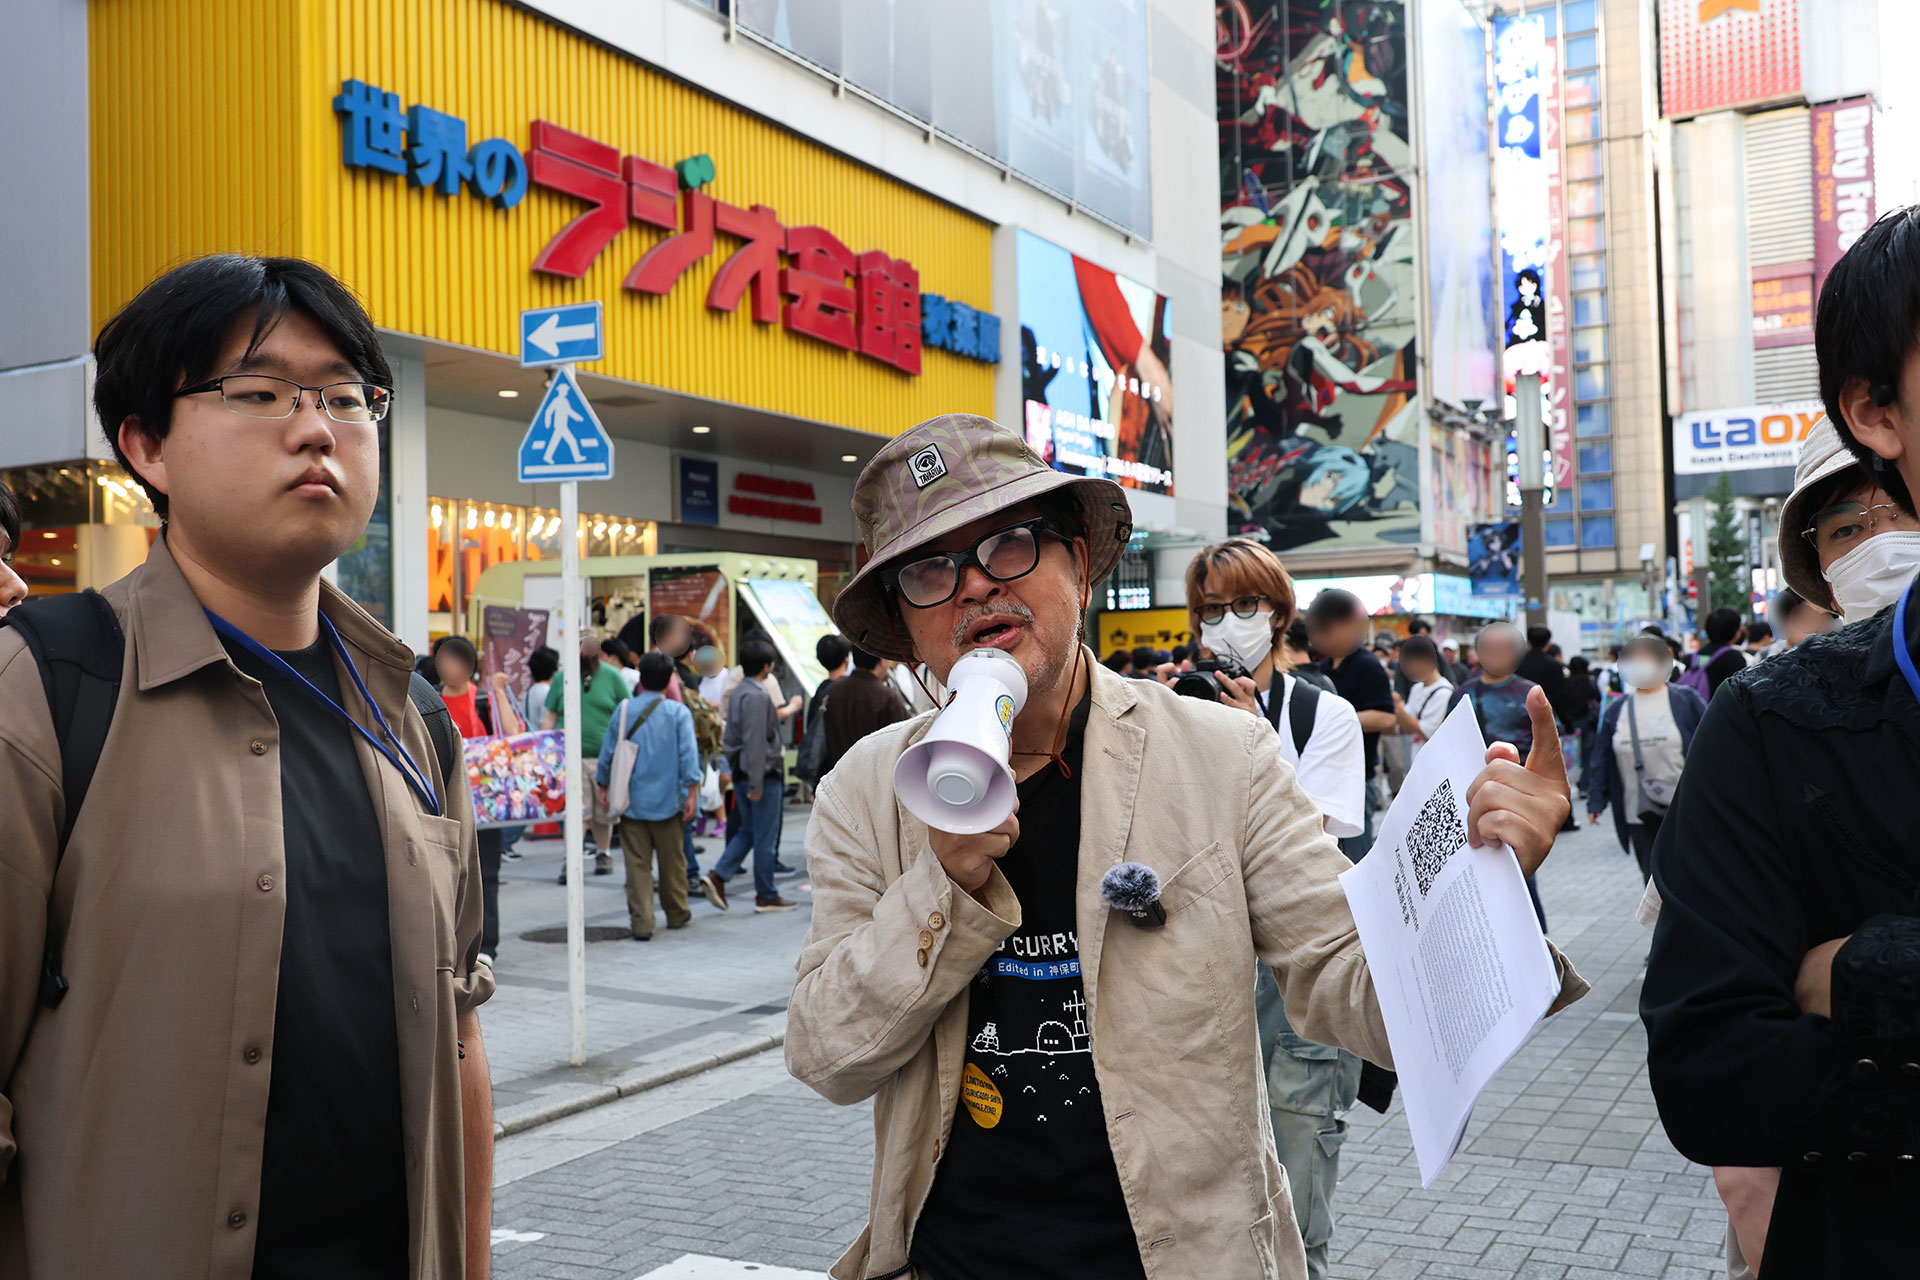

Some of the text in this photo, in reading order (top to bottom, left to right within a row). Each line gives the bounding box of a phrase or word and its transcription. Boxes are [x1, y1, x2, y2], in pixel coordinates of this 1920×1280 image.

[333, 78, 528, 209] 世界の
[524, 119, 921, 375] ラジオ会館
[1813, 112, 1835, 222] Flagship Store
[1832, 105, 1874, 252] Duty Free
[998, 961, 1080, 977] Edited in 神保町
